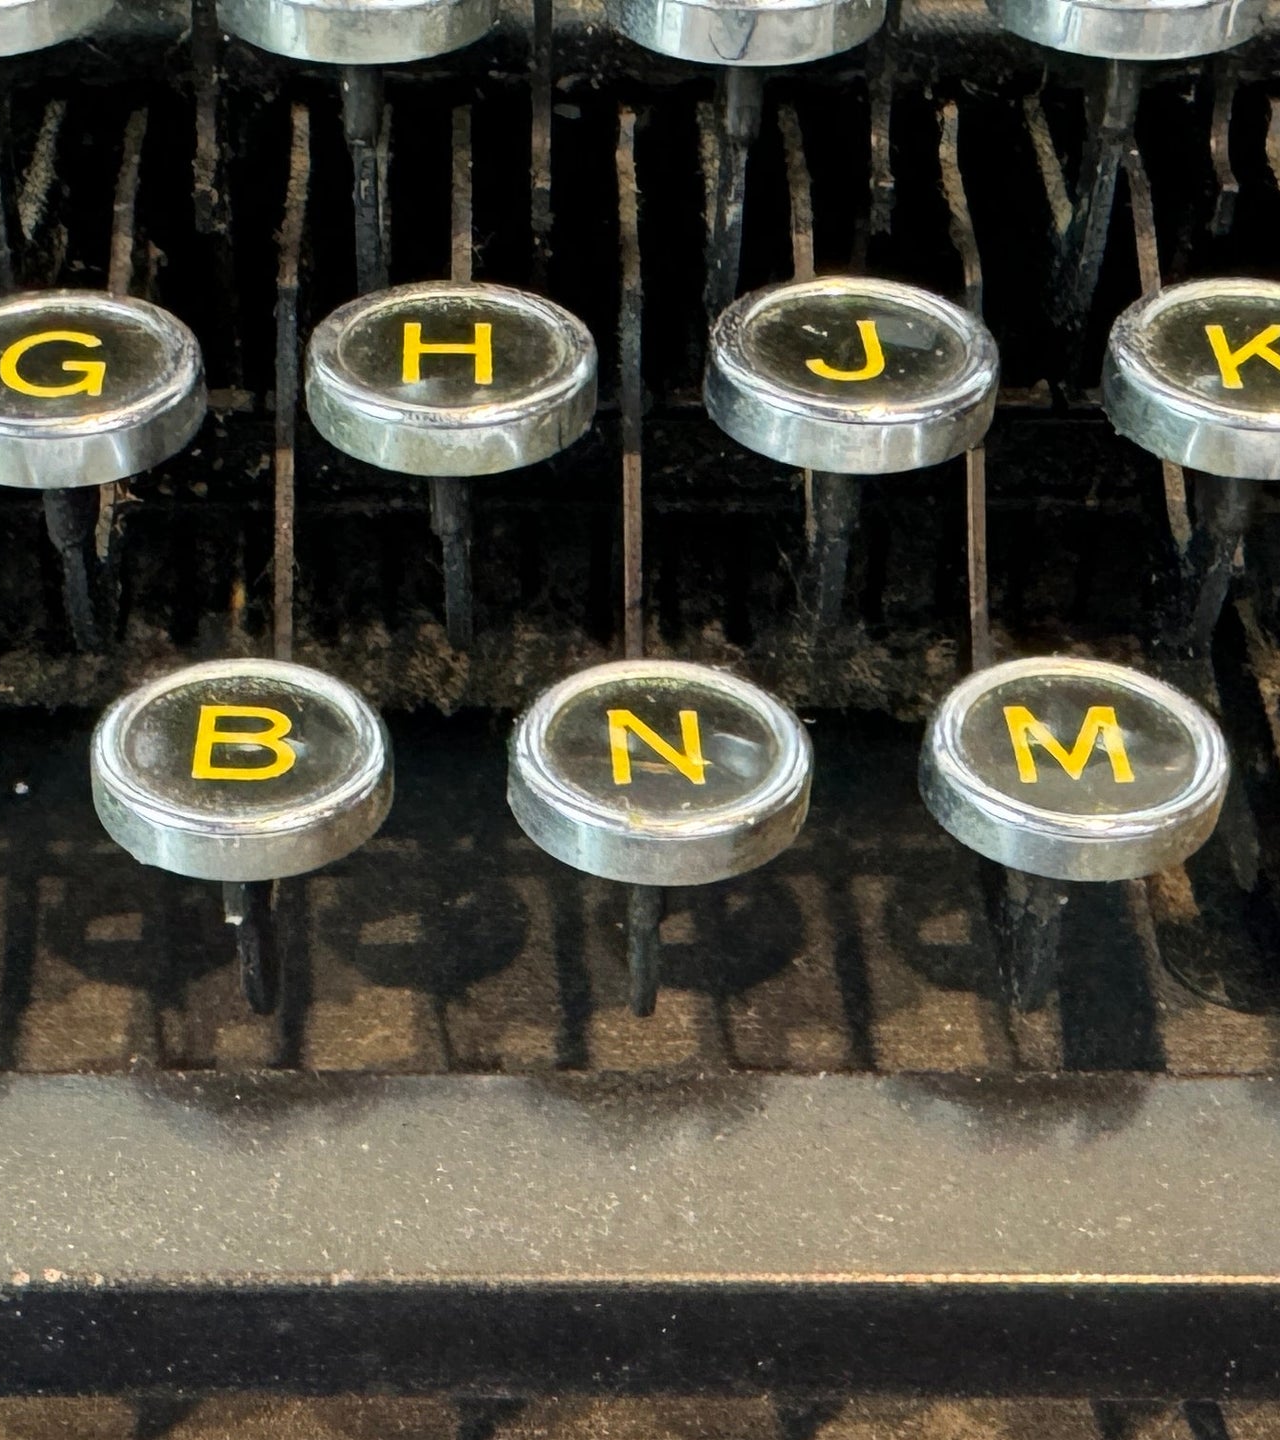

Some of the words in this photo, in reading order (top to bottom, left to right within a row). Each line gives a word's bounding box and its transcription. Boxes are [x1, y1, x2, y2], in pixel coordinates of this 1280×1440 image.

[400, 320, 495, 386] H
[806, 319, 887, 383] J
[190, 702, 299, 783] B
[606, 707, 709, 787] N
[1002, 703, 1136, 786] M
